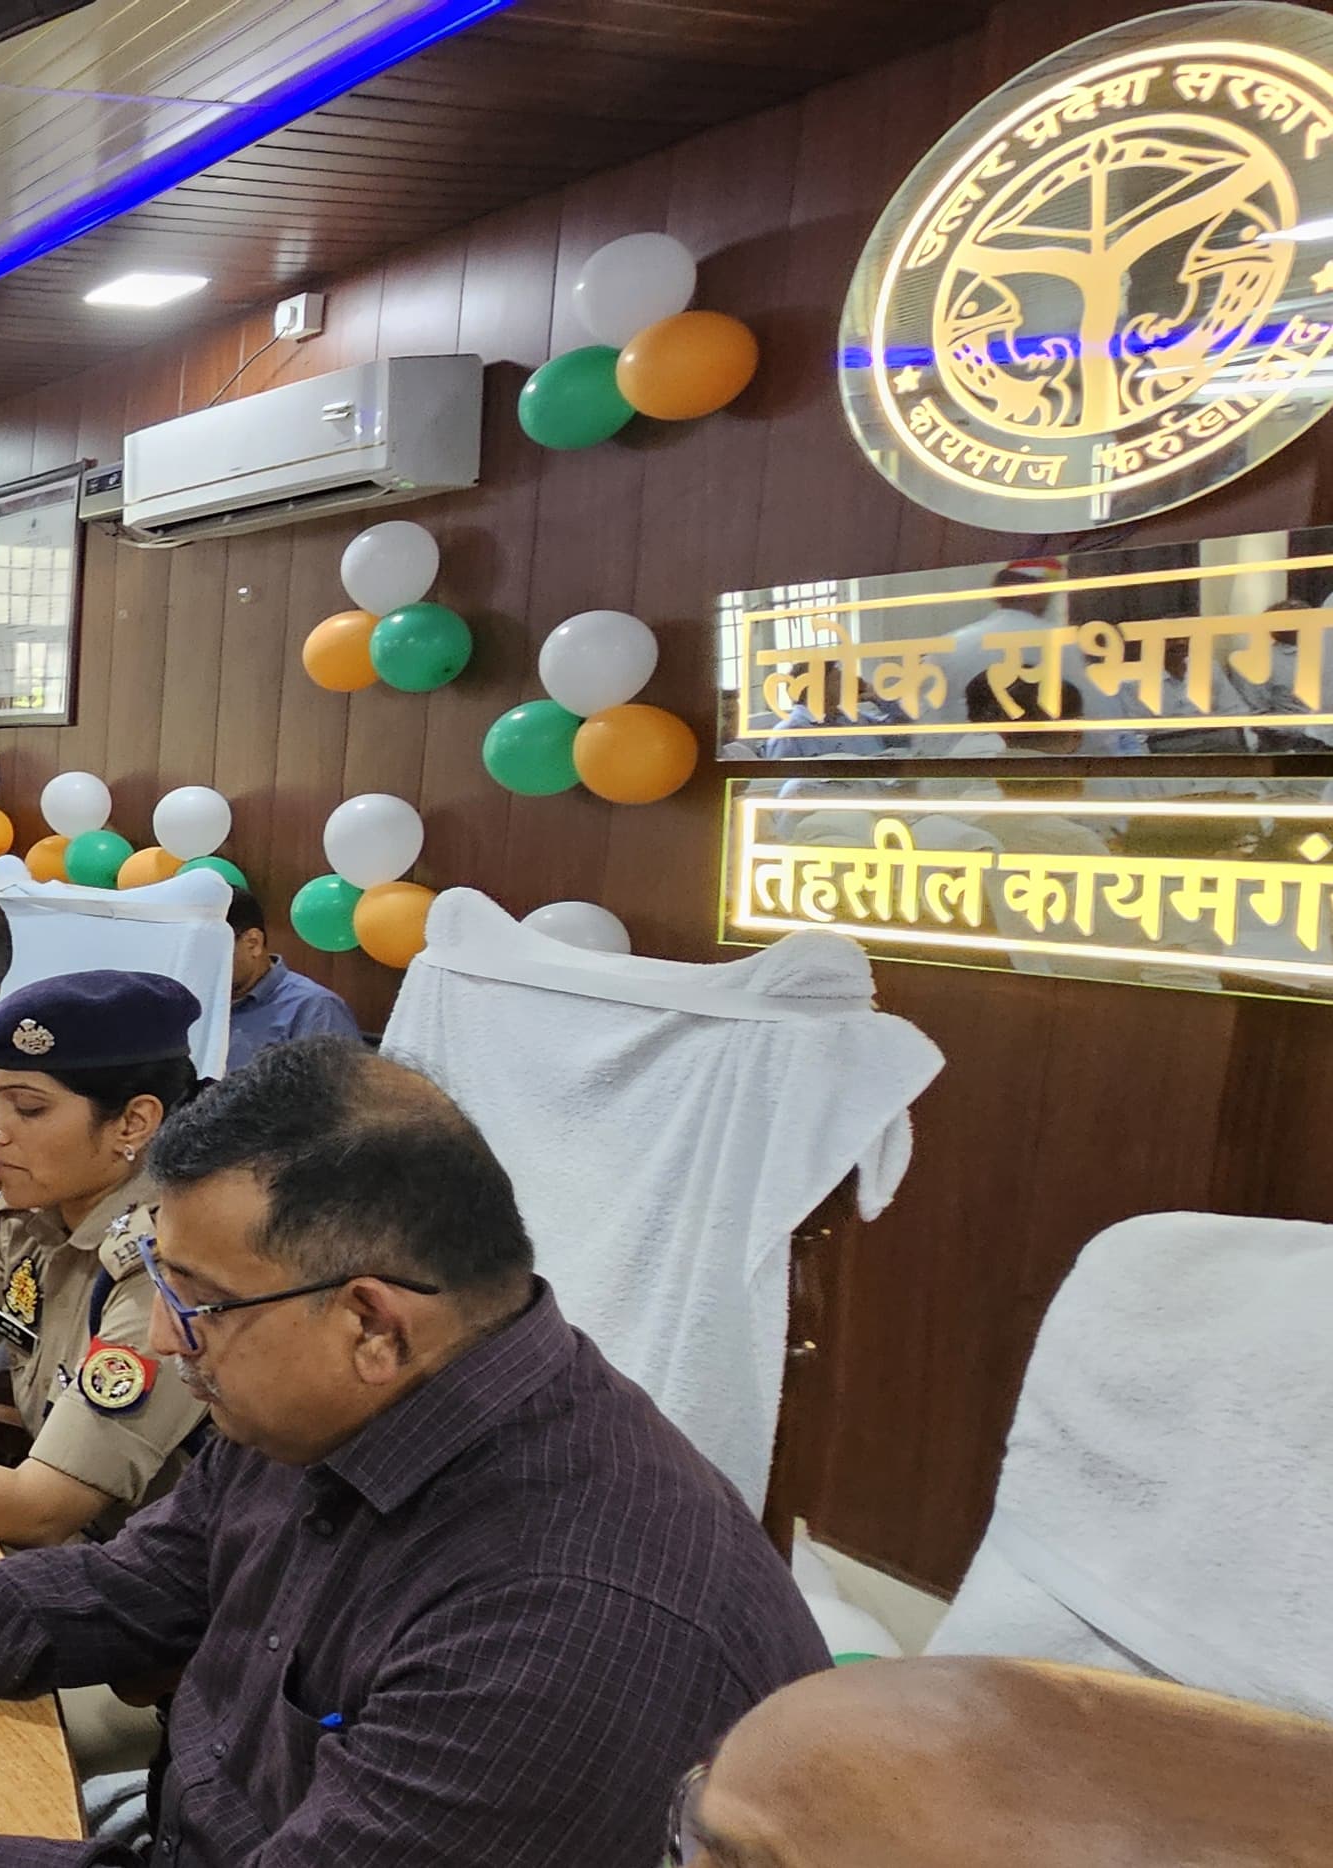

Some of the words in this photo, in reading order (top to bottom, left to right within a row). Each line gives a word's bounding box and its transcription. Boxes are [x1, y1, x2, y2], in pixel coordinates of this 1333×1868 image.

[1015, 65, 1162, 150] प्रदेश
[1173, 63, 1333, 160] सरकार
[909, 396, 1069, 487] कायमगंज
[756, 616, 956, 723] लोक
[982, 608, 1333, 719] सभाग
[751, 818, 993, 928] तहसील
[997, 832, 1333, 952] कायमगं
